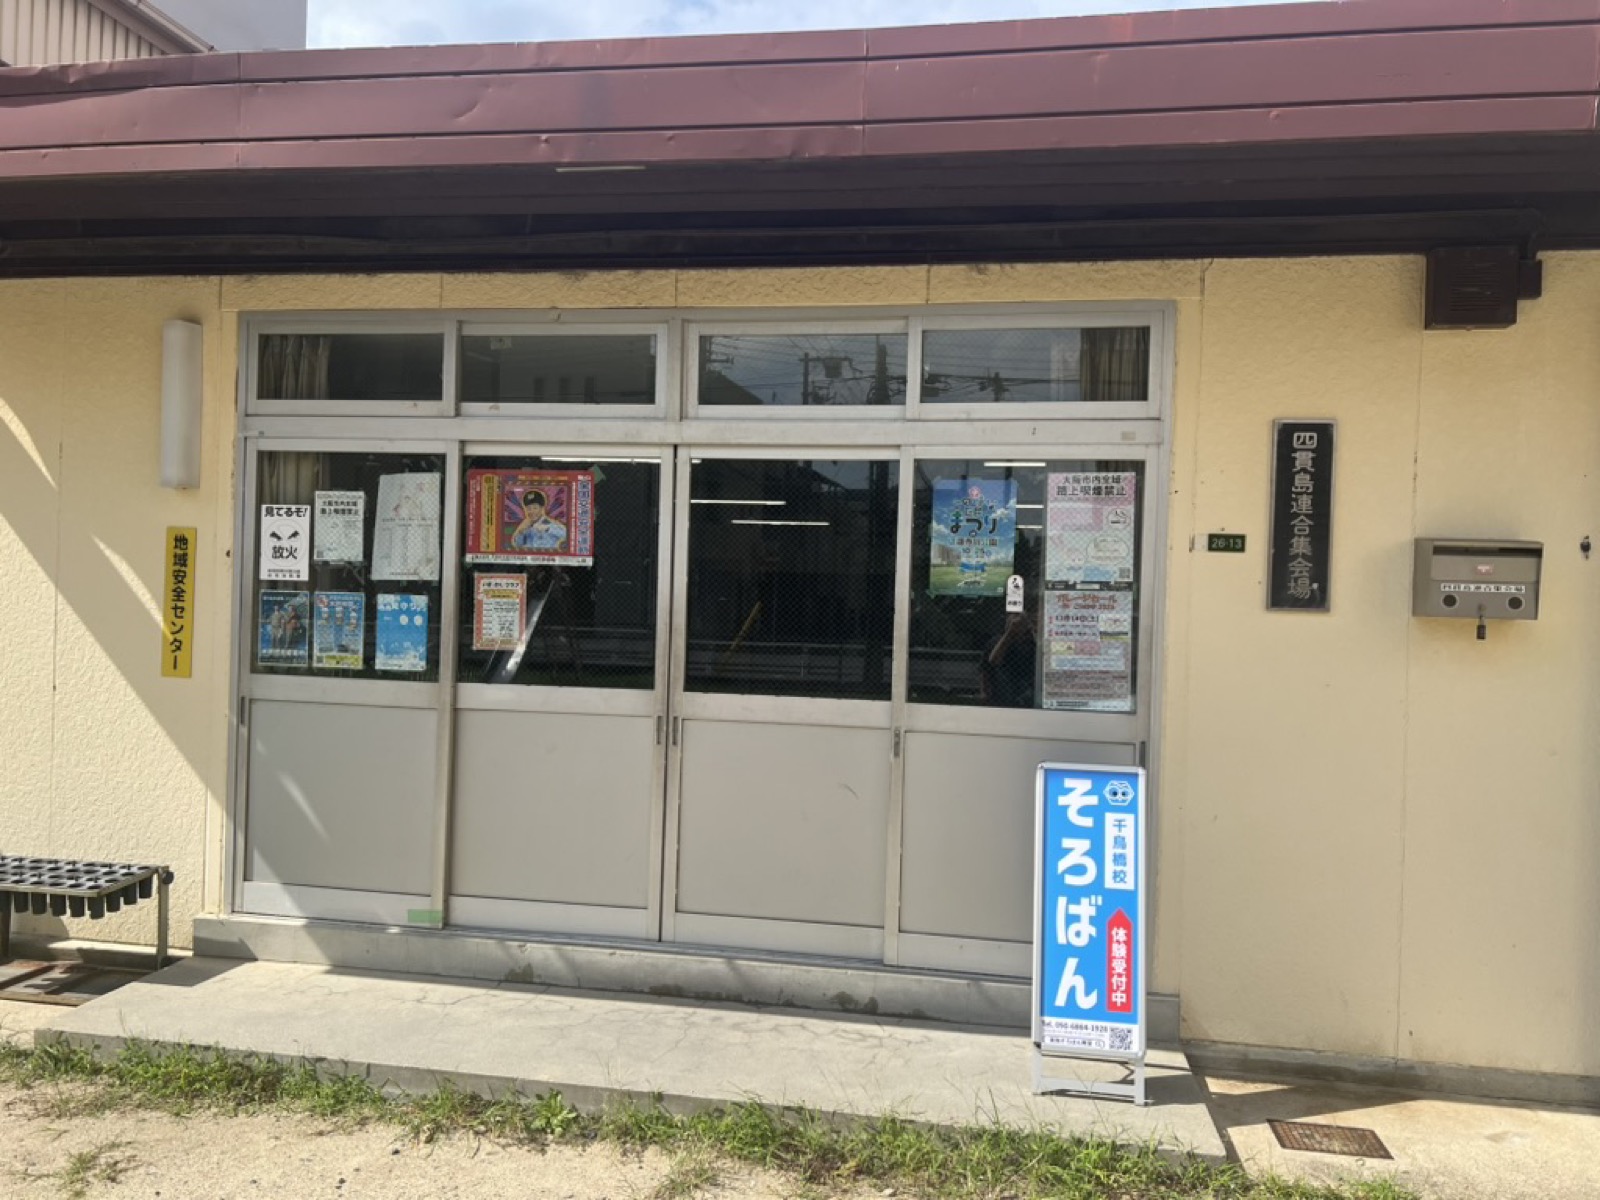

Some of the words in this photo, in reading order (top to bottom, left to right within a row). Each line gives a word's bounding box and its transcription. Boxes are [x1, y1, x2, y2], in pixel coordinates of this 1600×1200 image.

[271, 545, 298, 560] 放火
[1288, 432, 1317, 599] 四貫島連合集会場
[169, 533, 188, 671] 地域安全センター
[1055, 777, 1102, 1010] そろばん
[1112, 819, 1128, 884] 千鳥橋校
[1111, 927, 1128, 1007] 体験受付中
